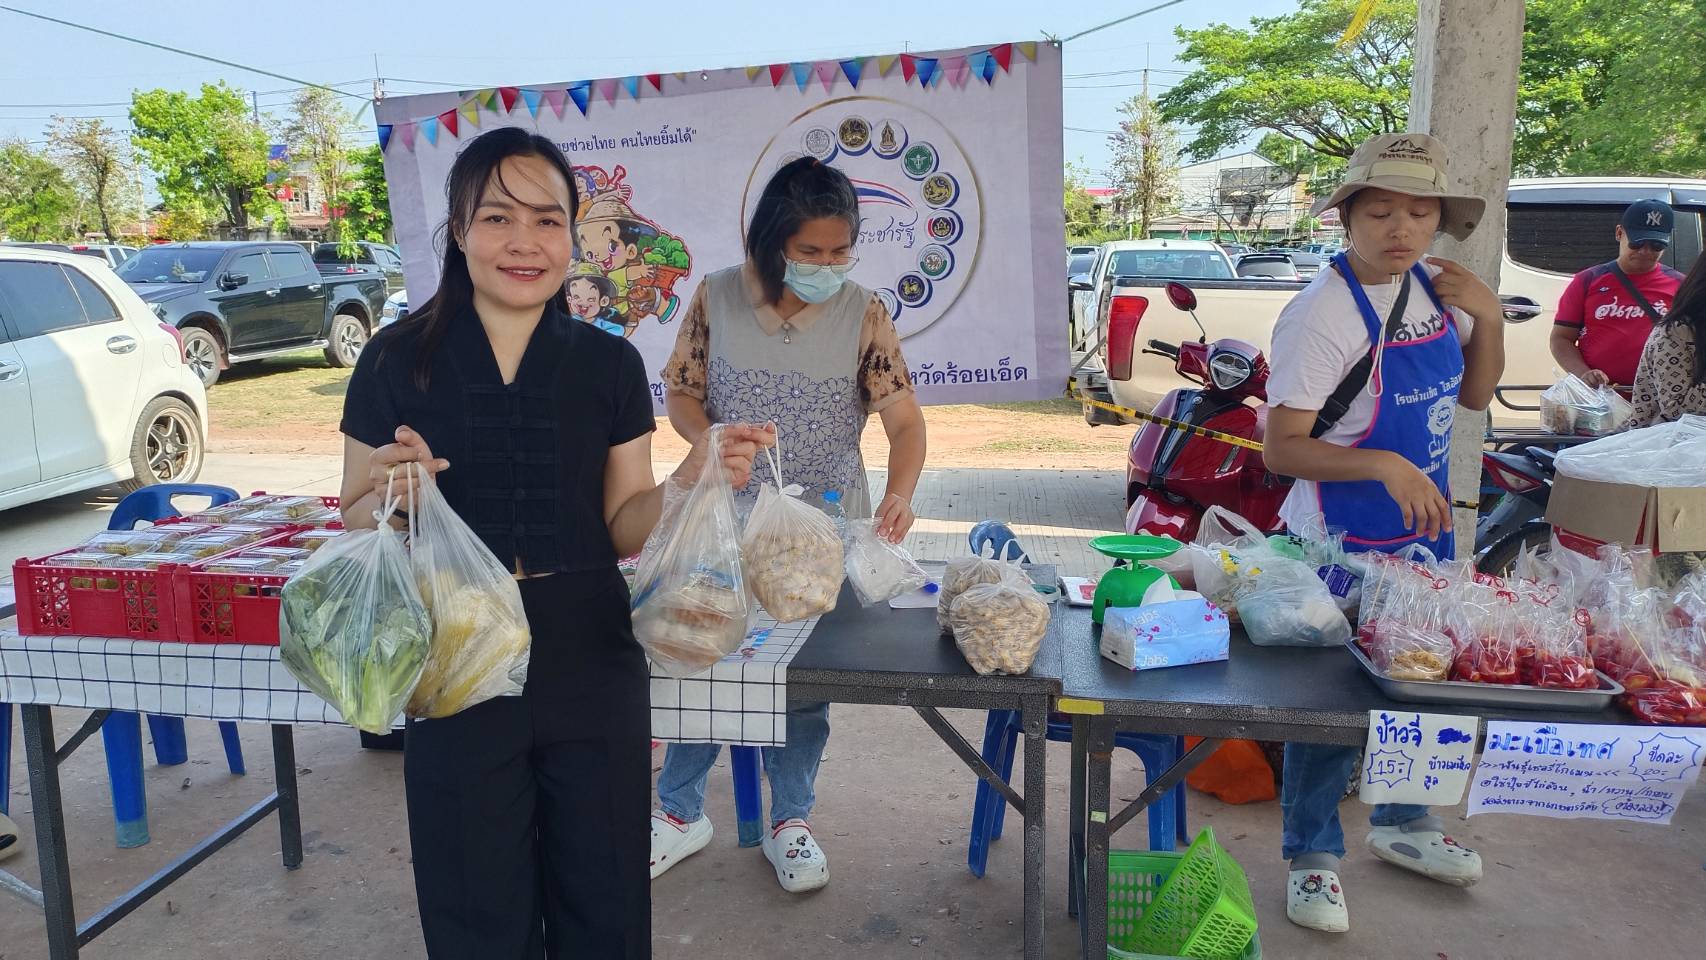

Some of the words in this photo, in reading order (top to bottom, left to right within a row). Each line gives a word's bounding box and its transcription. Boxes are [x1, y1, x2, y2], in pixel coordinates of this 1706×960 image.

[620, 124, 697, 148] คนไทยยิ้มได้"
[1646, 210, 1662, 226] NY
[1139, 653, 1169, 668] Jabs
[1488, 725, 1620, 760] มะเขือเทศ
